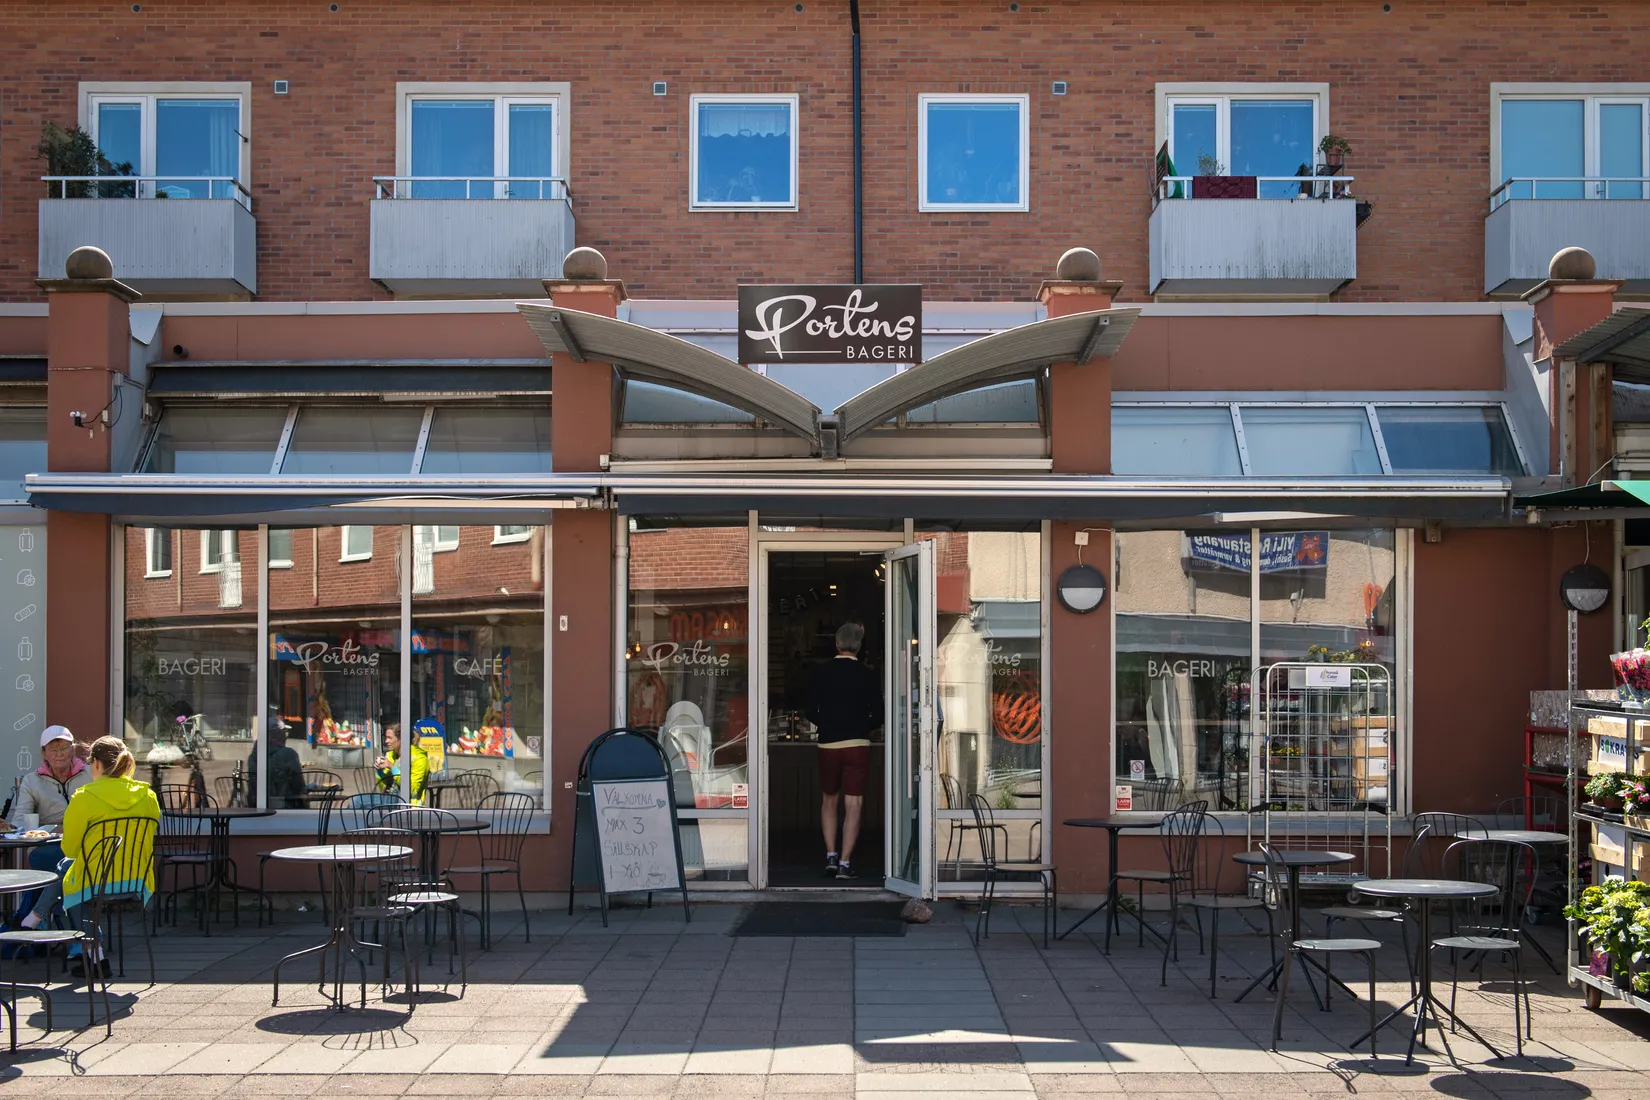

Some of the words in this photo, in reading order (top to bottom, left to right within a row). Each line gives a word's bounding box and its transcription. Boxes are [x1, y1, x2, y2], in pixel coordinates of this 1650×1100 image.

[745, 289, 916, 359] Portens
[846, 345, 914, 359] BAGERI
[291, 639, 380, 675] Portens
[454, 653, 503, 676] CAFÉ
[641, 639, 730, 676] Portens
[158, 658, 226, 675] BAGERI
[343, 667, 379, 676] BAGERI
[693, 668, 729, 677] BAGERI
[985, 668, 1021, 676] BAGERI
[1147, 660, 1215, 678] BAGERI
[604, 818, 628, 834] MAX
[632, 816, 645, 835] 3
